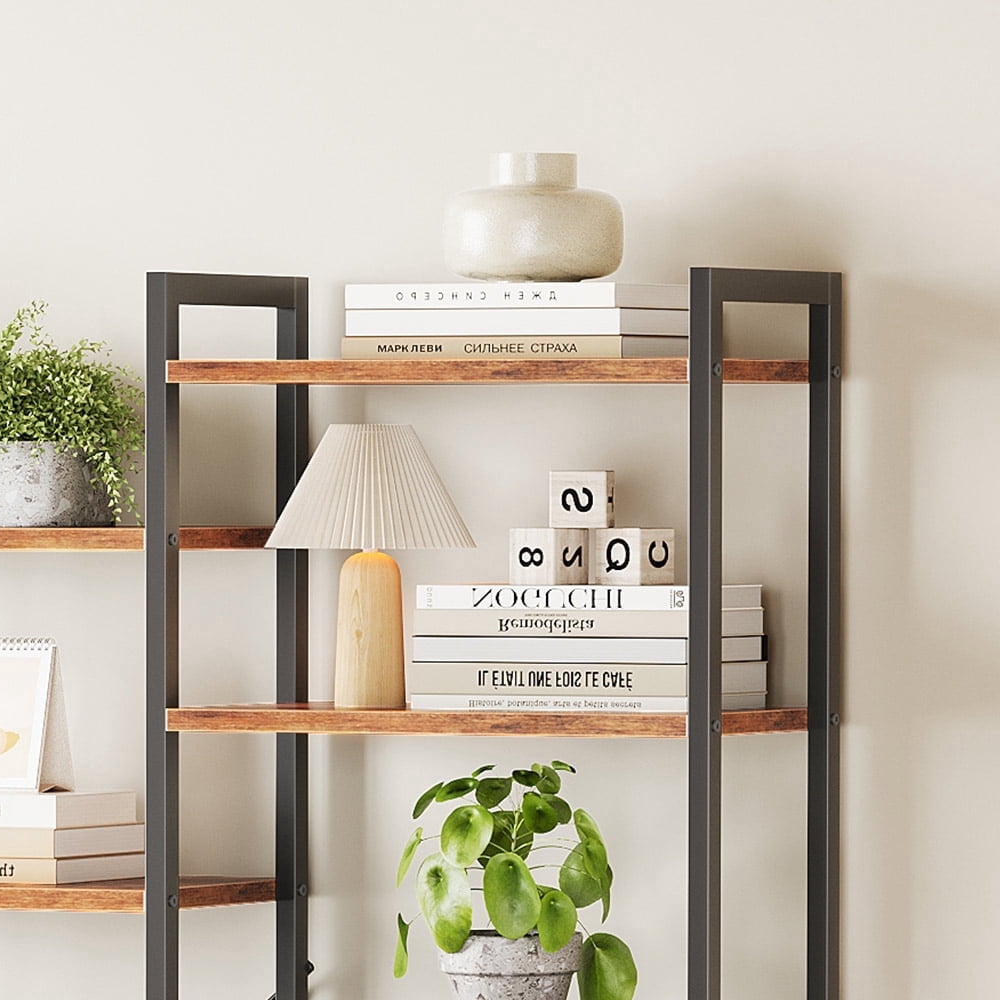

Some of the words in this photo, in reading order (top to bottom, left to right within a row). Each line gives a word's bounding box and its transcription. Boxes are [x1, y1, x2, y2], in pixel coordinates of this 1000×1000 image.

[377, 344, 409, 353] МАРК
[410, 344, 443, 353] ЛЕВИ
[464, 343, 525, 354] СИЛЬНЕЕ
[530, 343, 578, 353] СТРАХА
